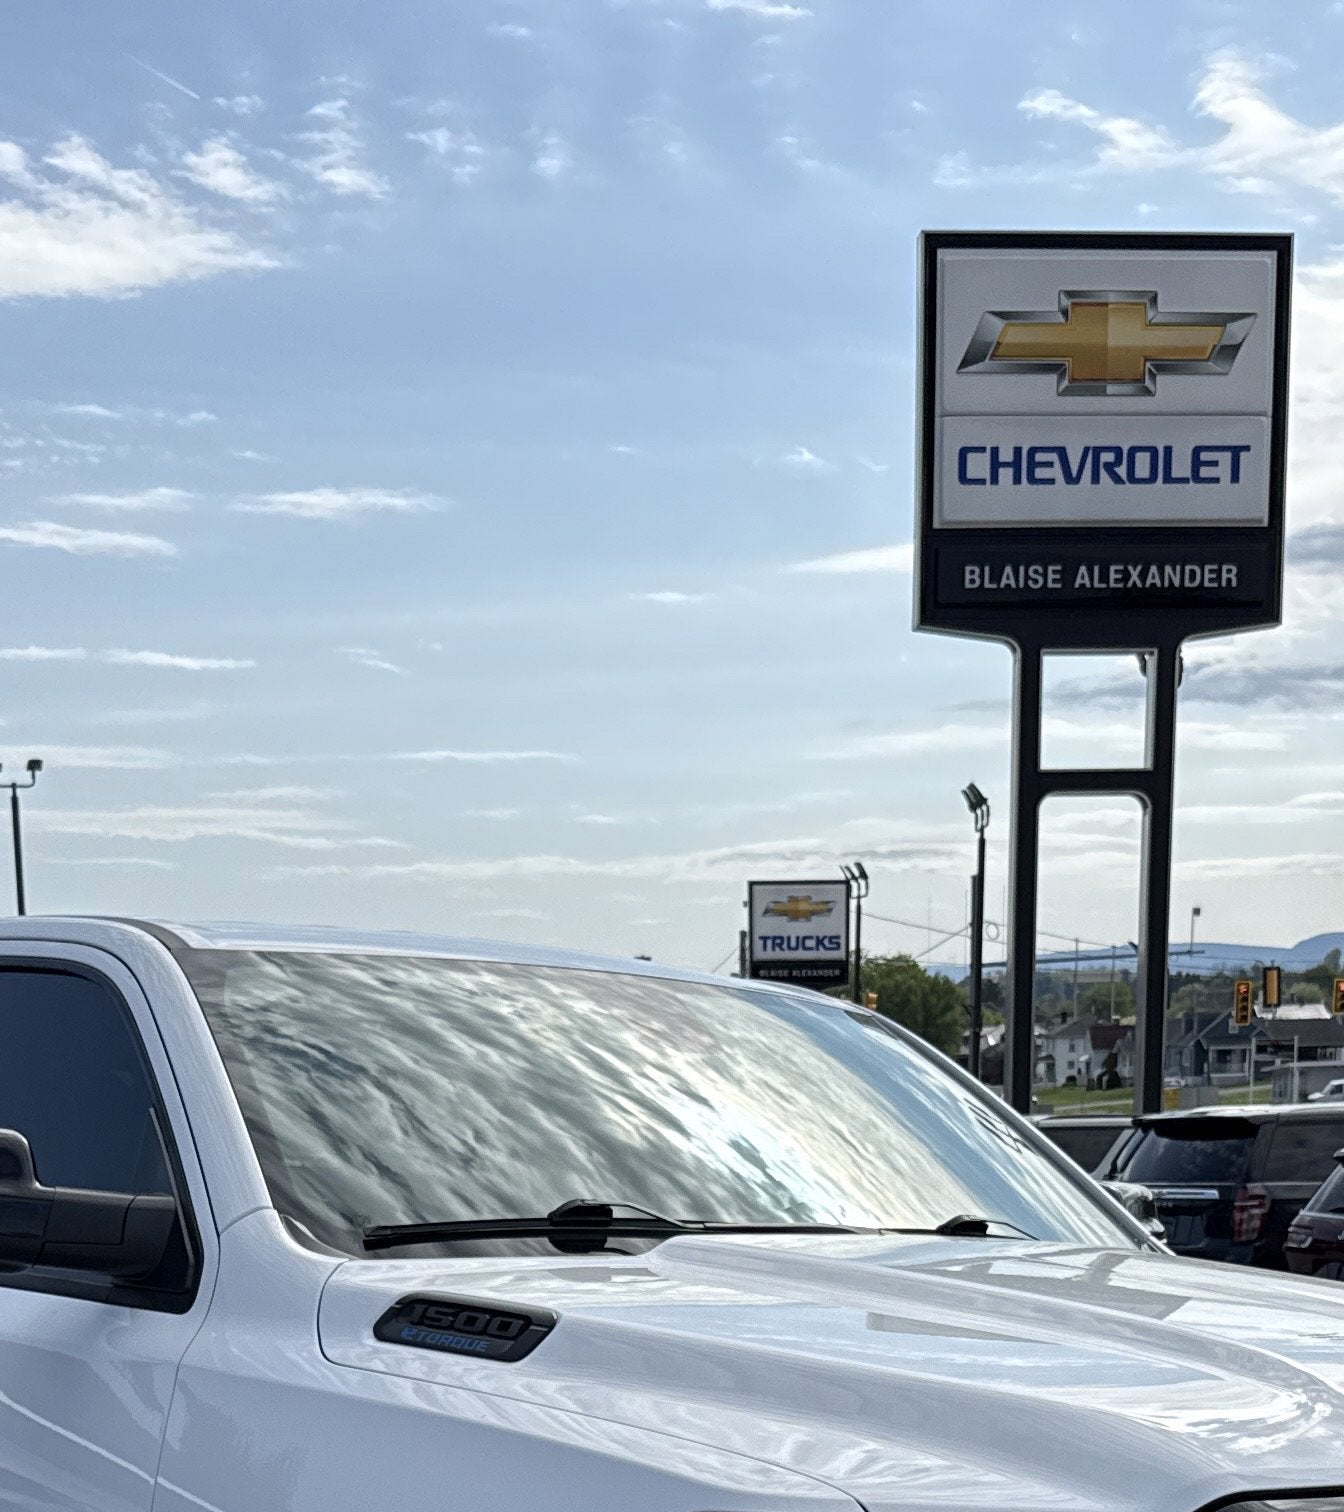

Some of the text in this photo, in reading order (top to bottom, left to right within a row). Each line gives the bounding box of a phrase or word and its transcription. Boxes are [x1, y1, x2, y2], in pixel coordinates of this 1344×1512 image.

[958, 445, 1251, 485] CHEVROLET
[963, 564, 1239, 589] BLAISE ALEXANDER
[758, 935, 841, 951] TRUCKS
[400, 1304, 523, 1338] 1500
